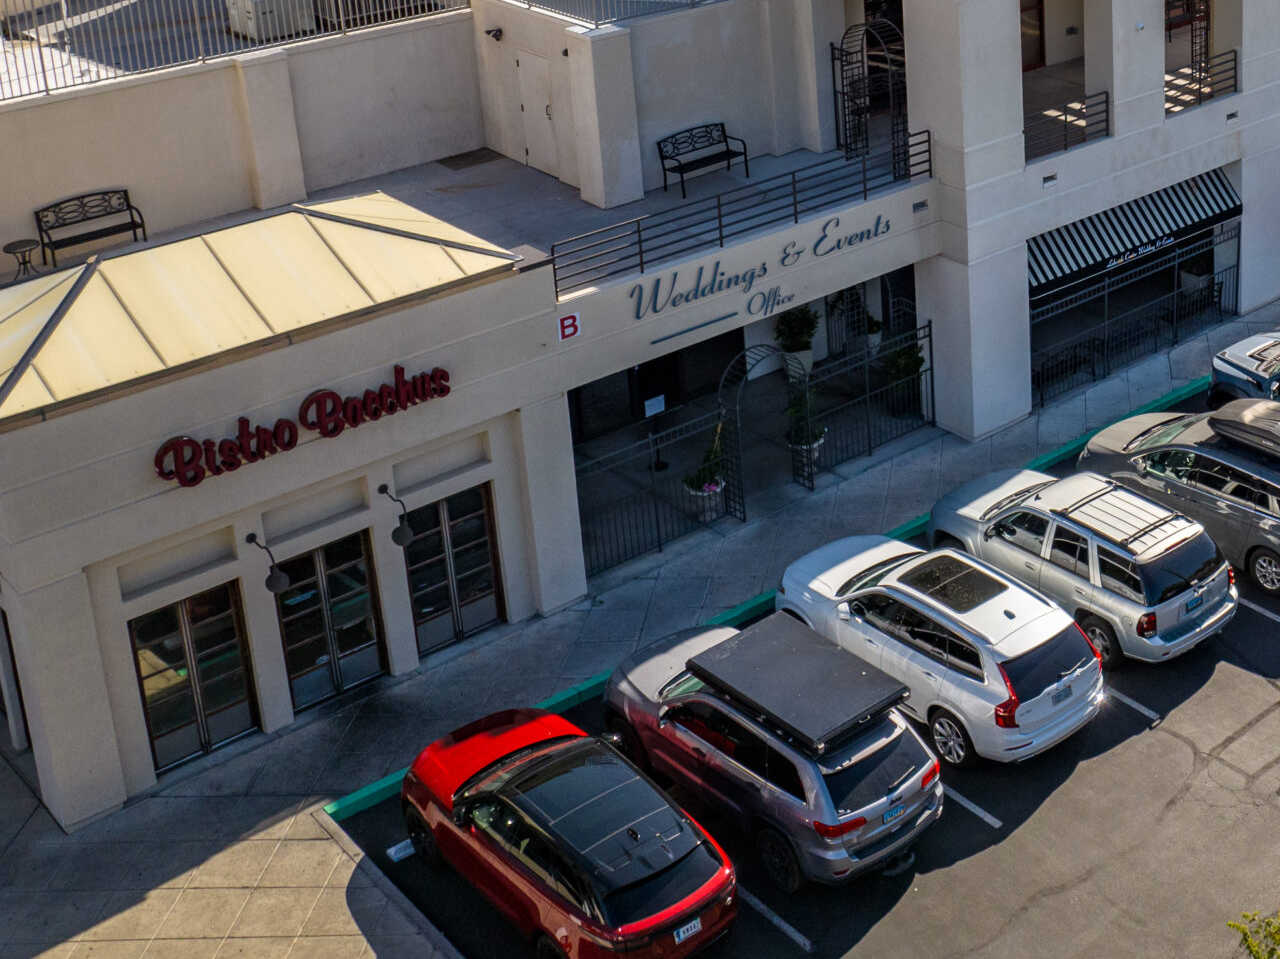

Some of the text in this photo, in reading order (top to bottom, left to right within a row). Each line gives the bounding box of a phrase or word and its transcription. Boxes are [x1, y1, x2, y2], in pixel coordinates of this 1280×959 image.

[629, 214, 891, 320] Weddings & Events
[747, 285, 795, 316] Office
[560, 315, 580, 339] B
[154, 364, 451, 488] Bistro Bacchus
